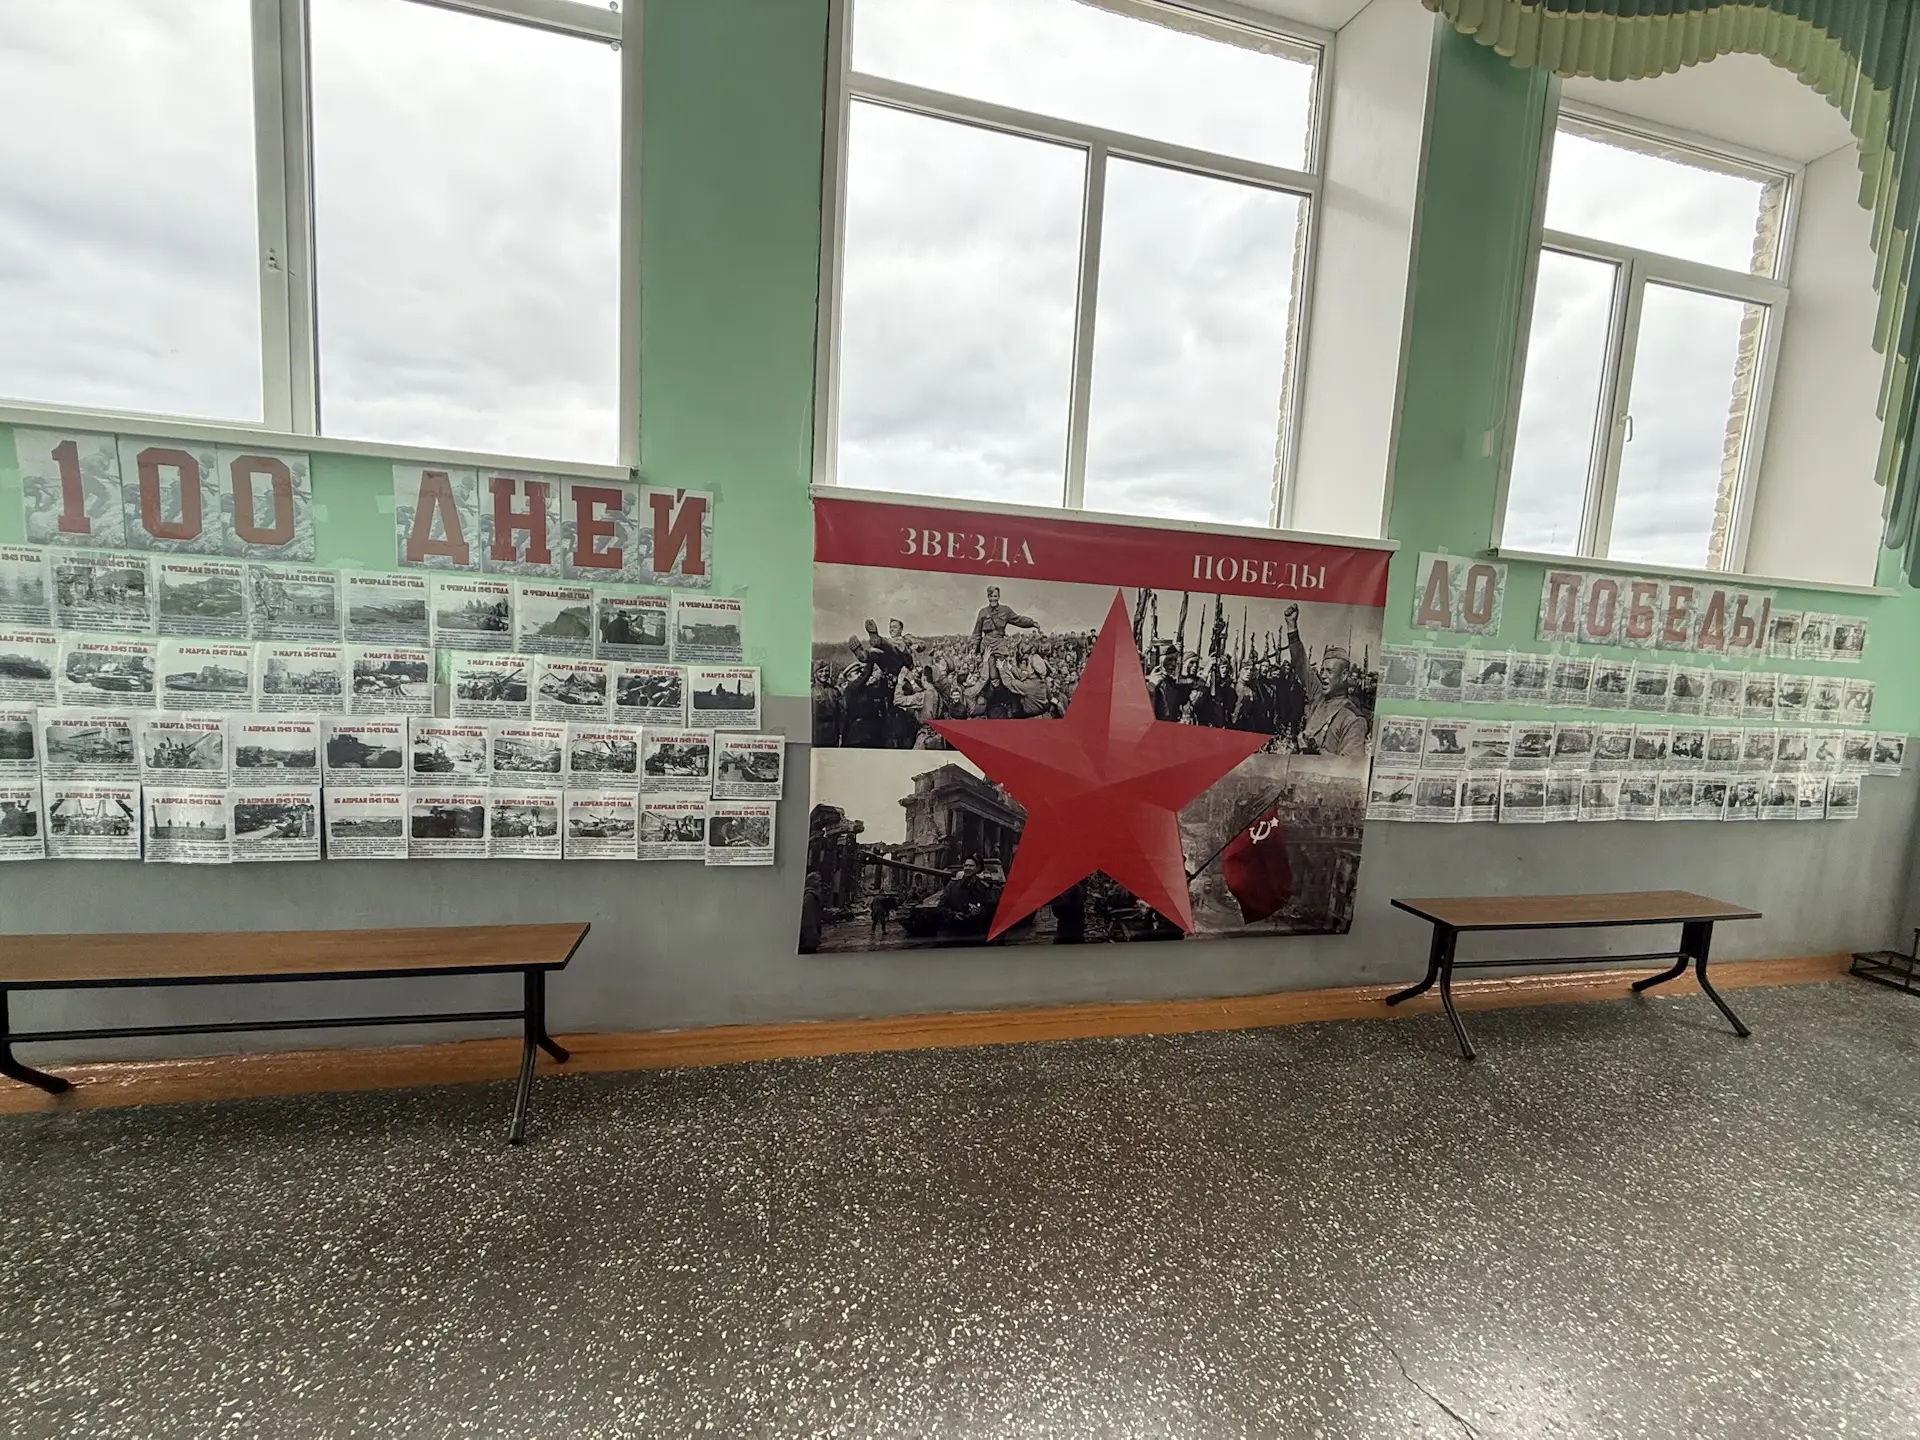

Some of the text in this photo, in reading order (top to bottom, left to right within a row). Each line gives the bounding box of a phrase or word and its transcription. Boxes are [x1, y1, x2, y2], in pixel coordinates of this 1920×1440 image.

[51, 440, 708, 576] 100 ДНЕЙ
[900, 527, 1035, 568] ЗВЕЗДА
[1191, 553, 1326, 590] ПОБЕДЫ
[1417, 559, 1497, 628] ДО
[1544, 571, 1772, 650] ПОБЕДЫ
